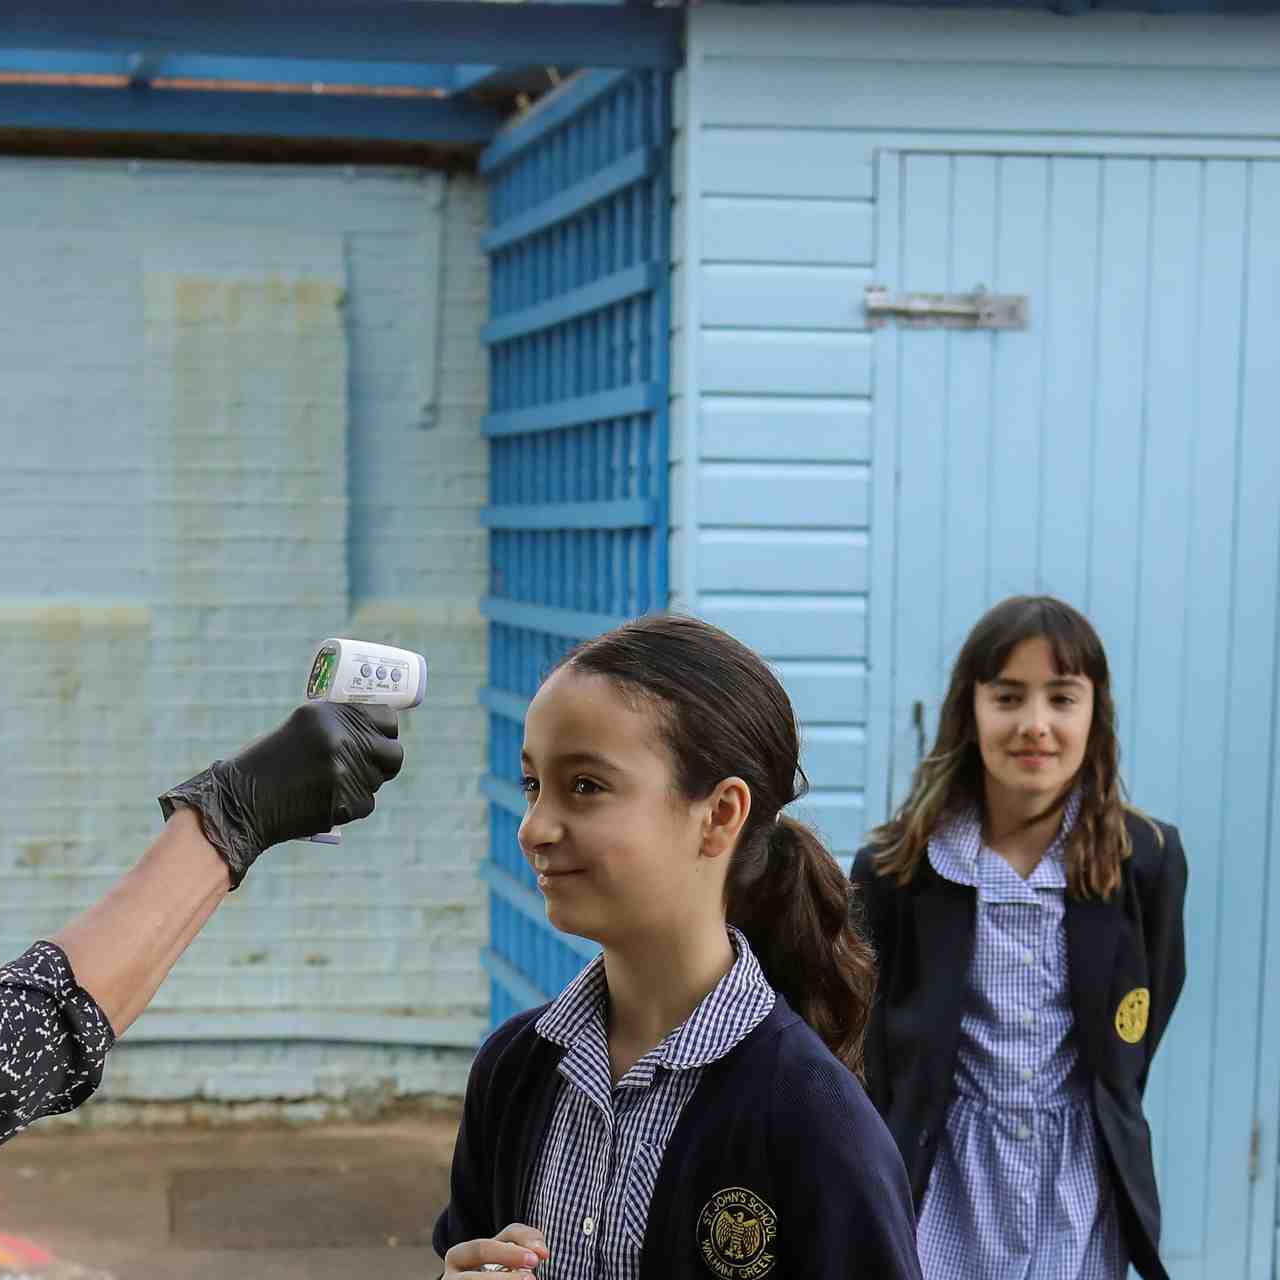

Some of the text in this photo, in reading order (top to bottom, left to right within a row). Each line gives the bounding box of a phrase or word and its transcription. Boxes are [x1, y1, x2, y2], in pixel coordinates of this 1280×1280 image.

[713, 1191, 747, 1212] JOHN'S
[748, 1197, 777, 1242] SCHOOL
[738, 1251, 775, 1279] GREEN
